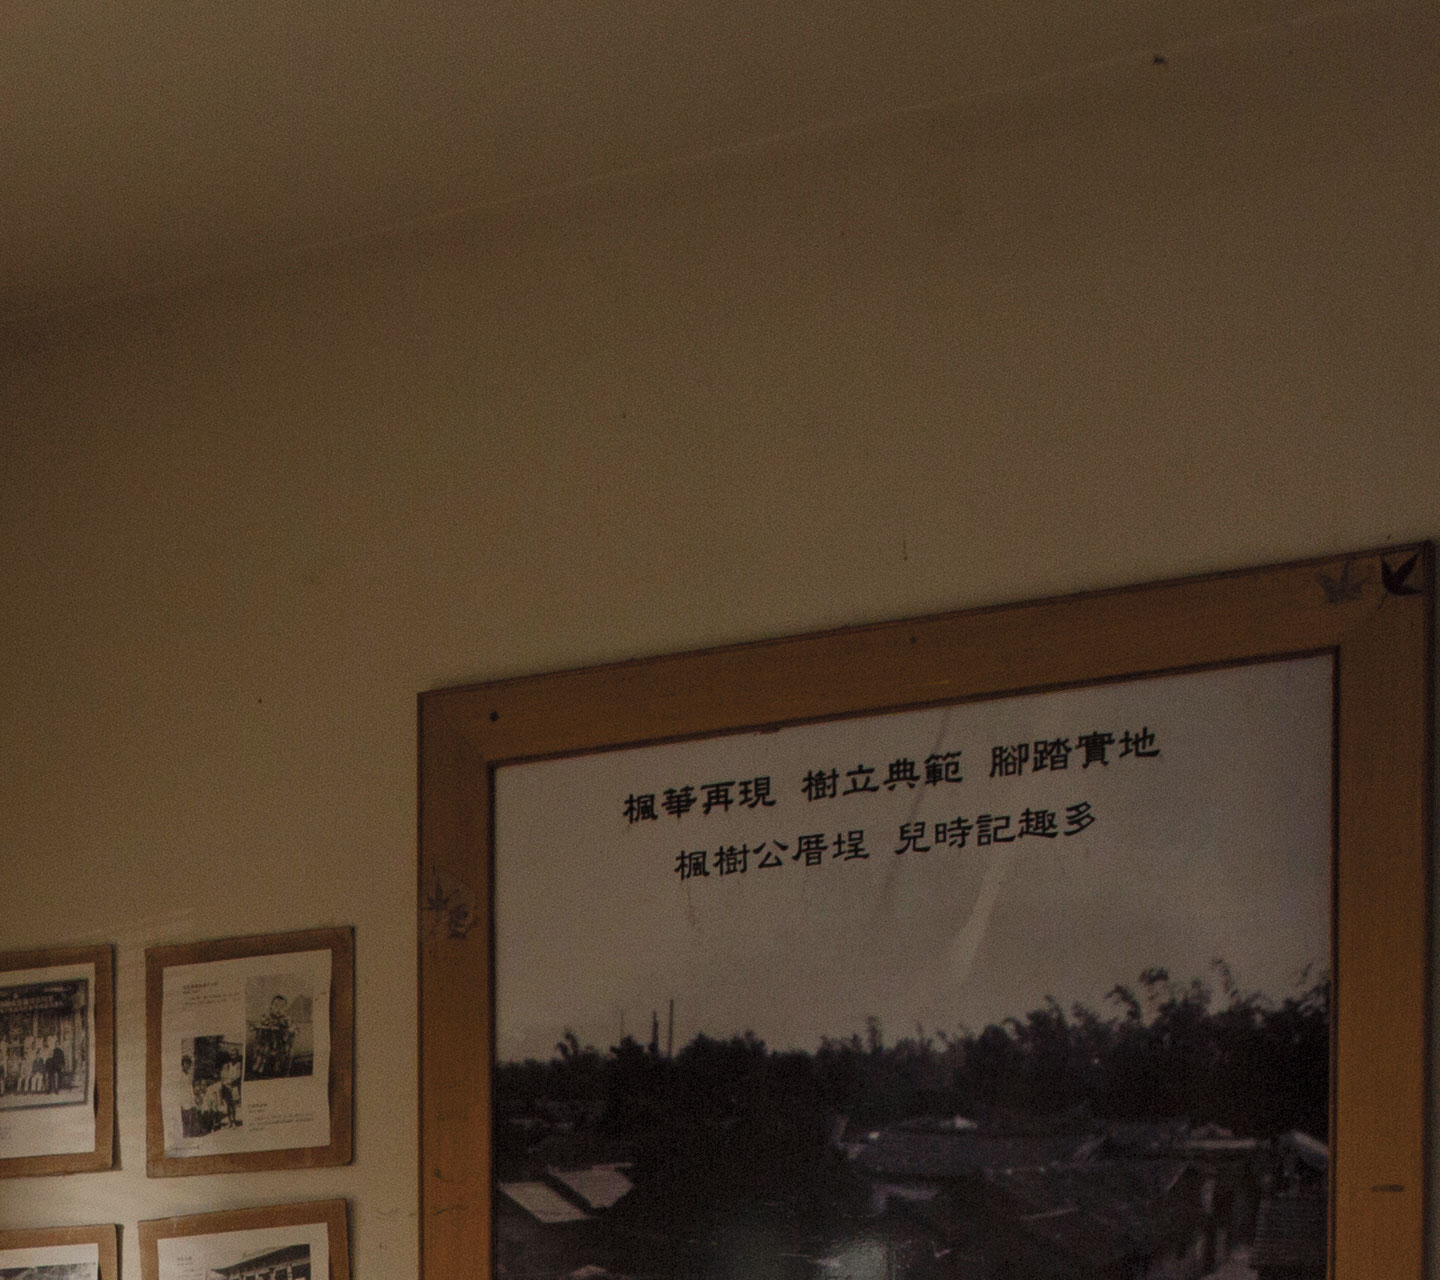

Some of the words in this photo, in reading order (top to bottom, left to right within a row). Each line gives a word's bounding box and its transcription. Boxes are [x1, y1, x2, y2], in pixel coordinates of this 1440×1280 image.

[624, 774, 776, 823] 楓華再現
[801, 750, 963, 802] 樹立典範
[989, 726, 1160, 779] 腳踏實地
[895, 799, 1097, 856] 兒時記趣多
